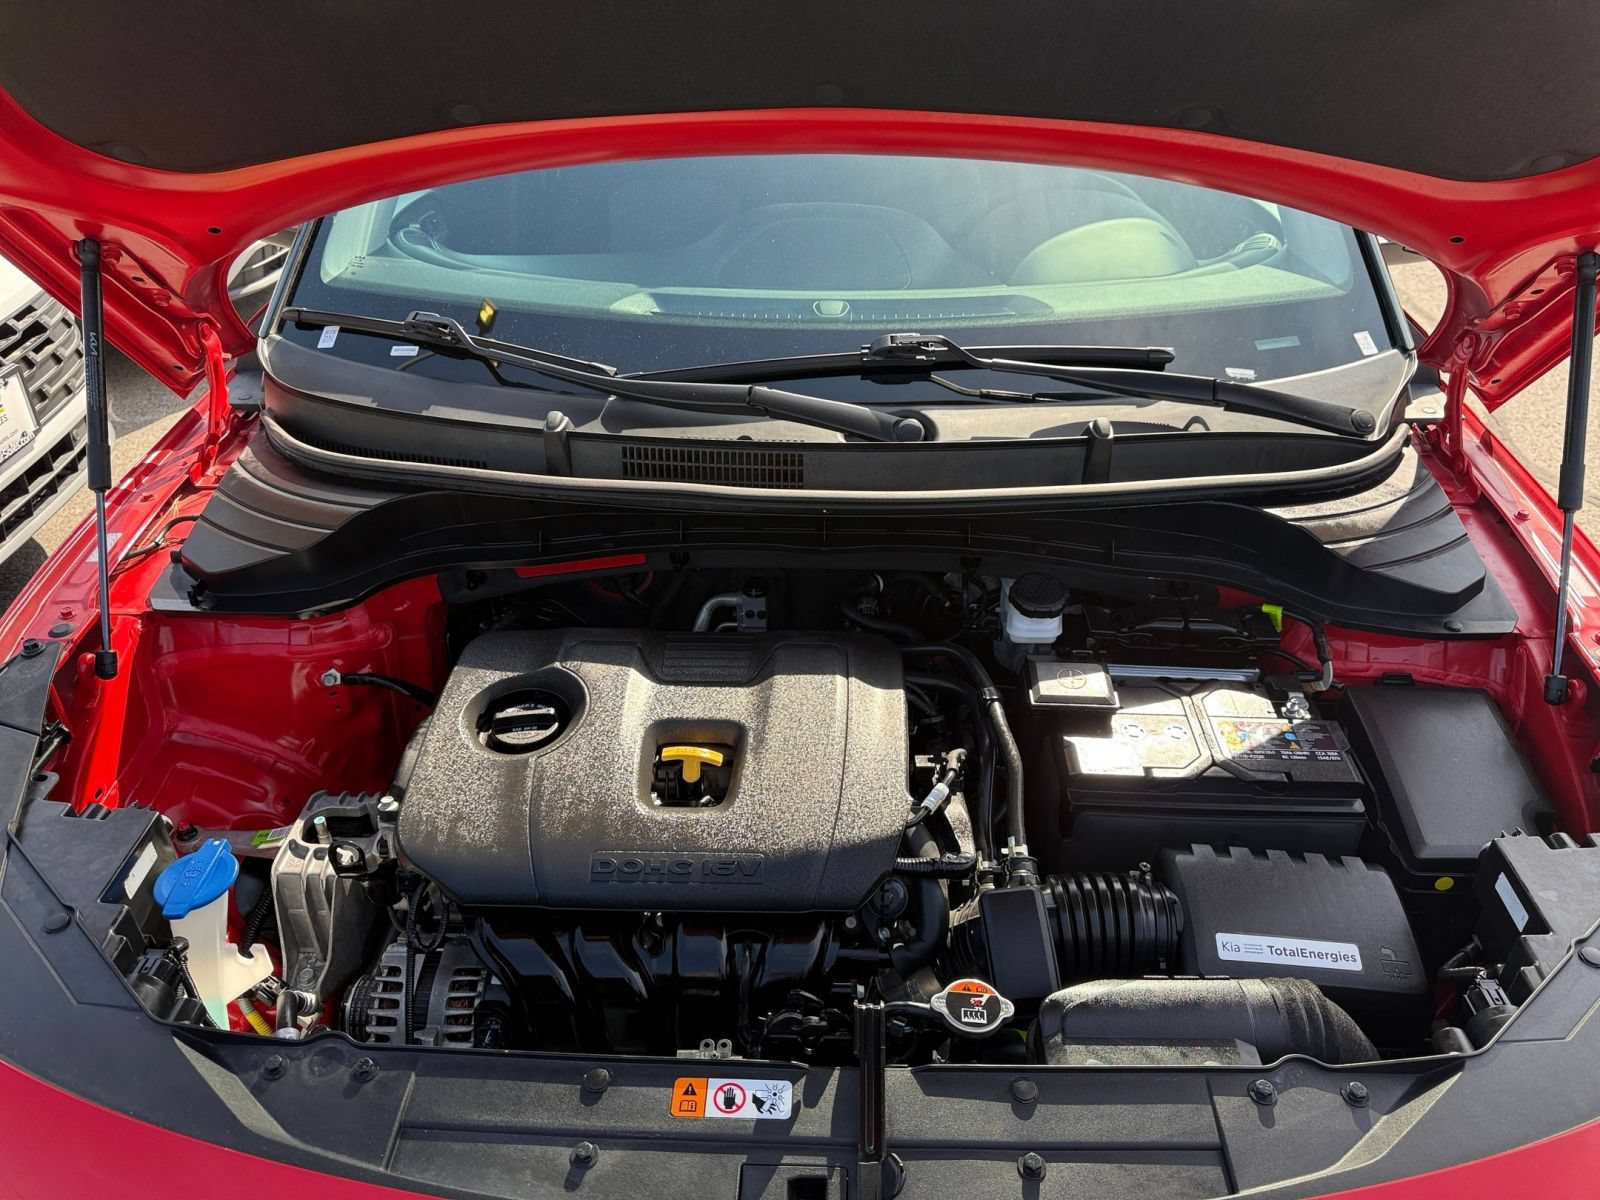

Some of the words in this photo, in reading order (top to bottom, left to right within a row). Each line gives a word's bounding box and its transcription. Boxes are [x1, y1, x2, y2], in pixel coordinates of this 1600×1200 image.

[591, 857, 694, 876] DOHC
[702, 858, 763, 877] 16V
[1221, 941, 1241, 953] Kia
[1267, 945, 1357, 963] TotalEnergies
